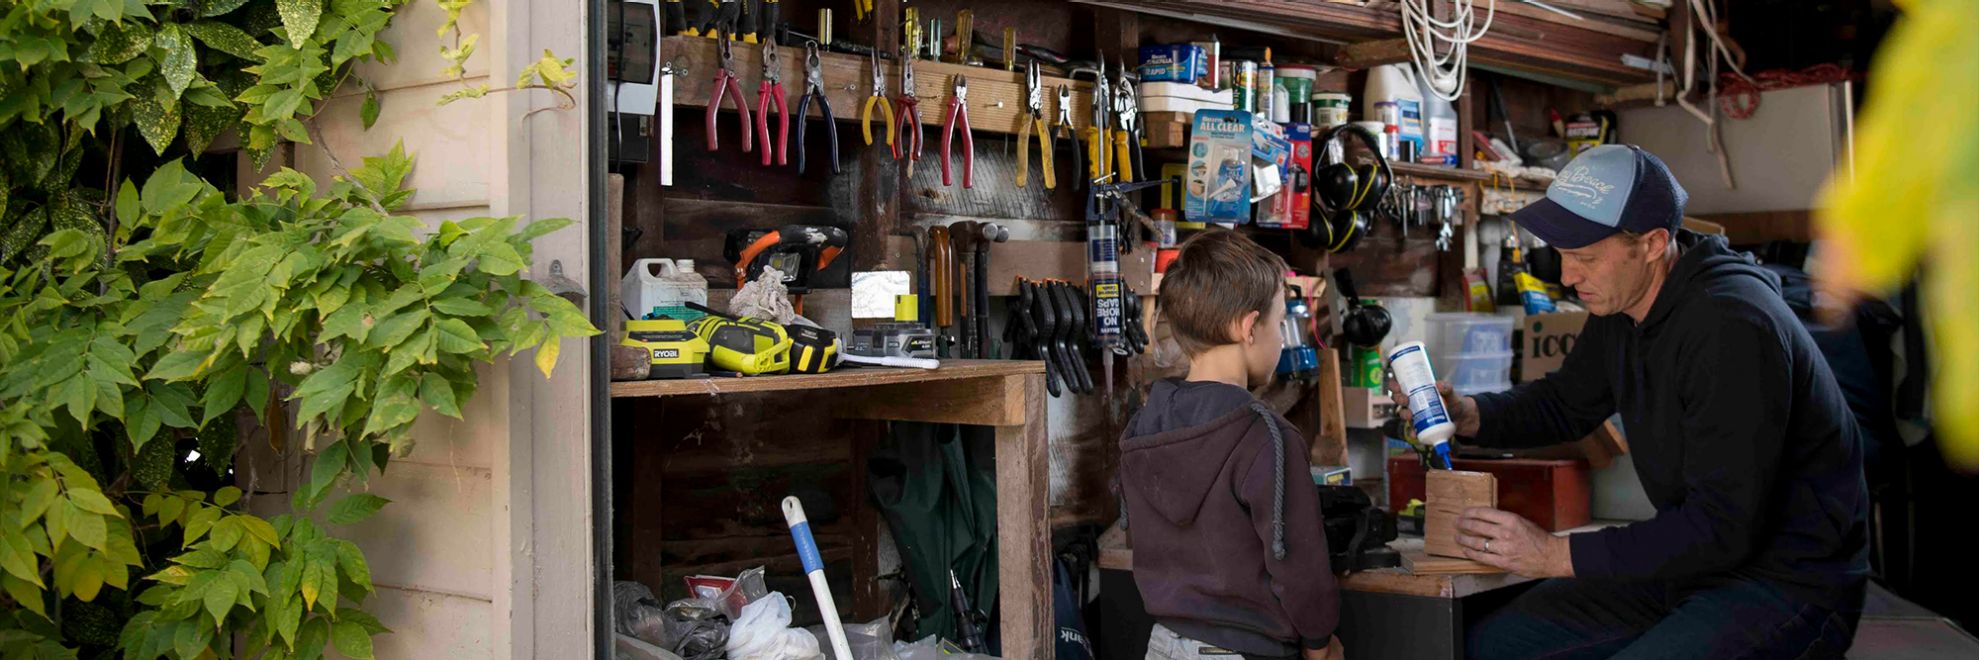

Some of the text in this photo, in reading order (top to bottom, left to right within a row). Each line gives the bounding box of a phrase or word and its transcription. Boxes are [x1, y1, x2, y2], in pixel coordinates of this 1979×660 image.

[1200, 122, 1245, 132] ALL CLEAR
[1097, 298, 1119, 307] GAPS
[1096, 308, 1120, 317] MORE
[1103, 317, 1118, 326] NO
